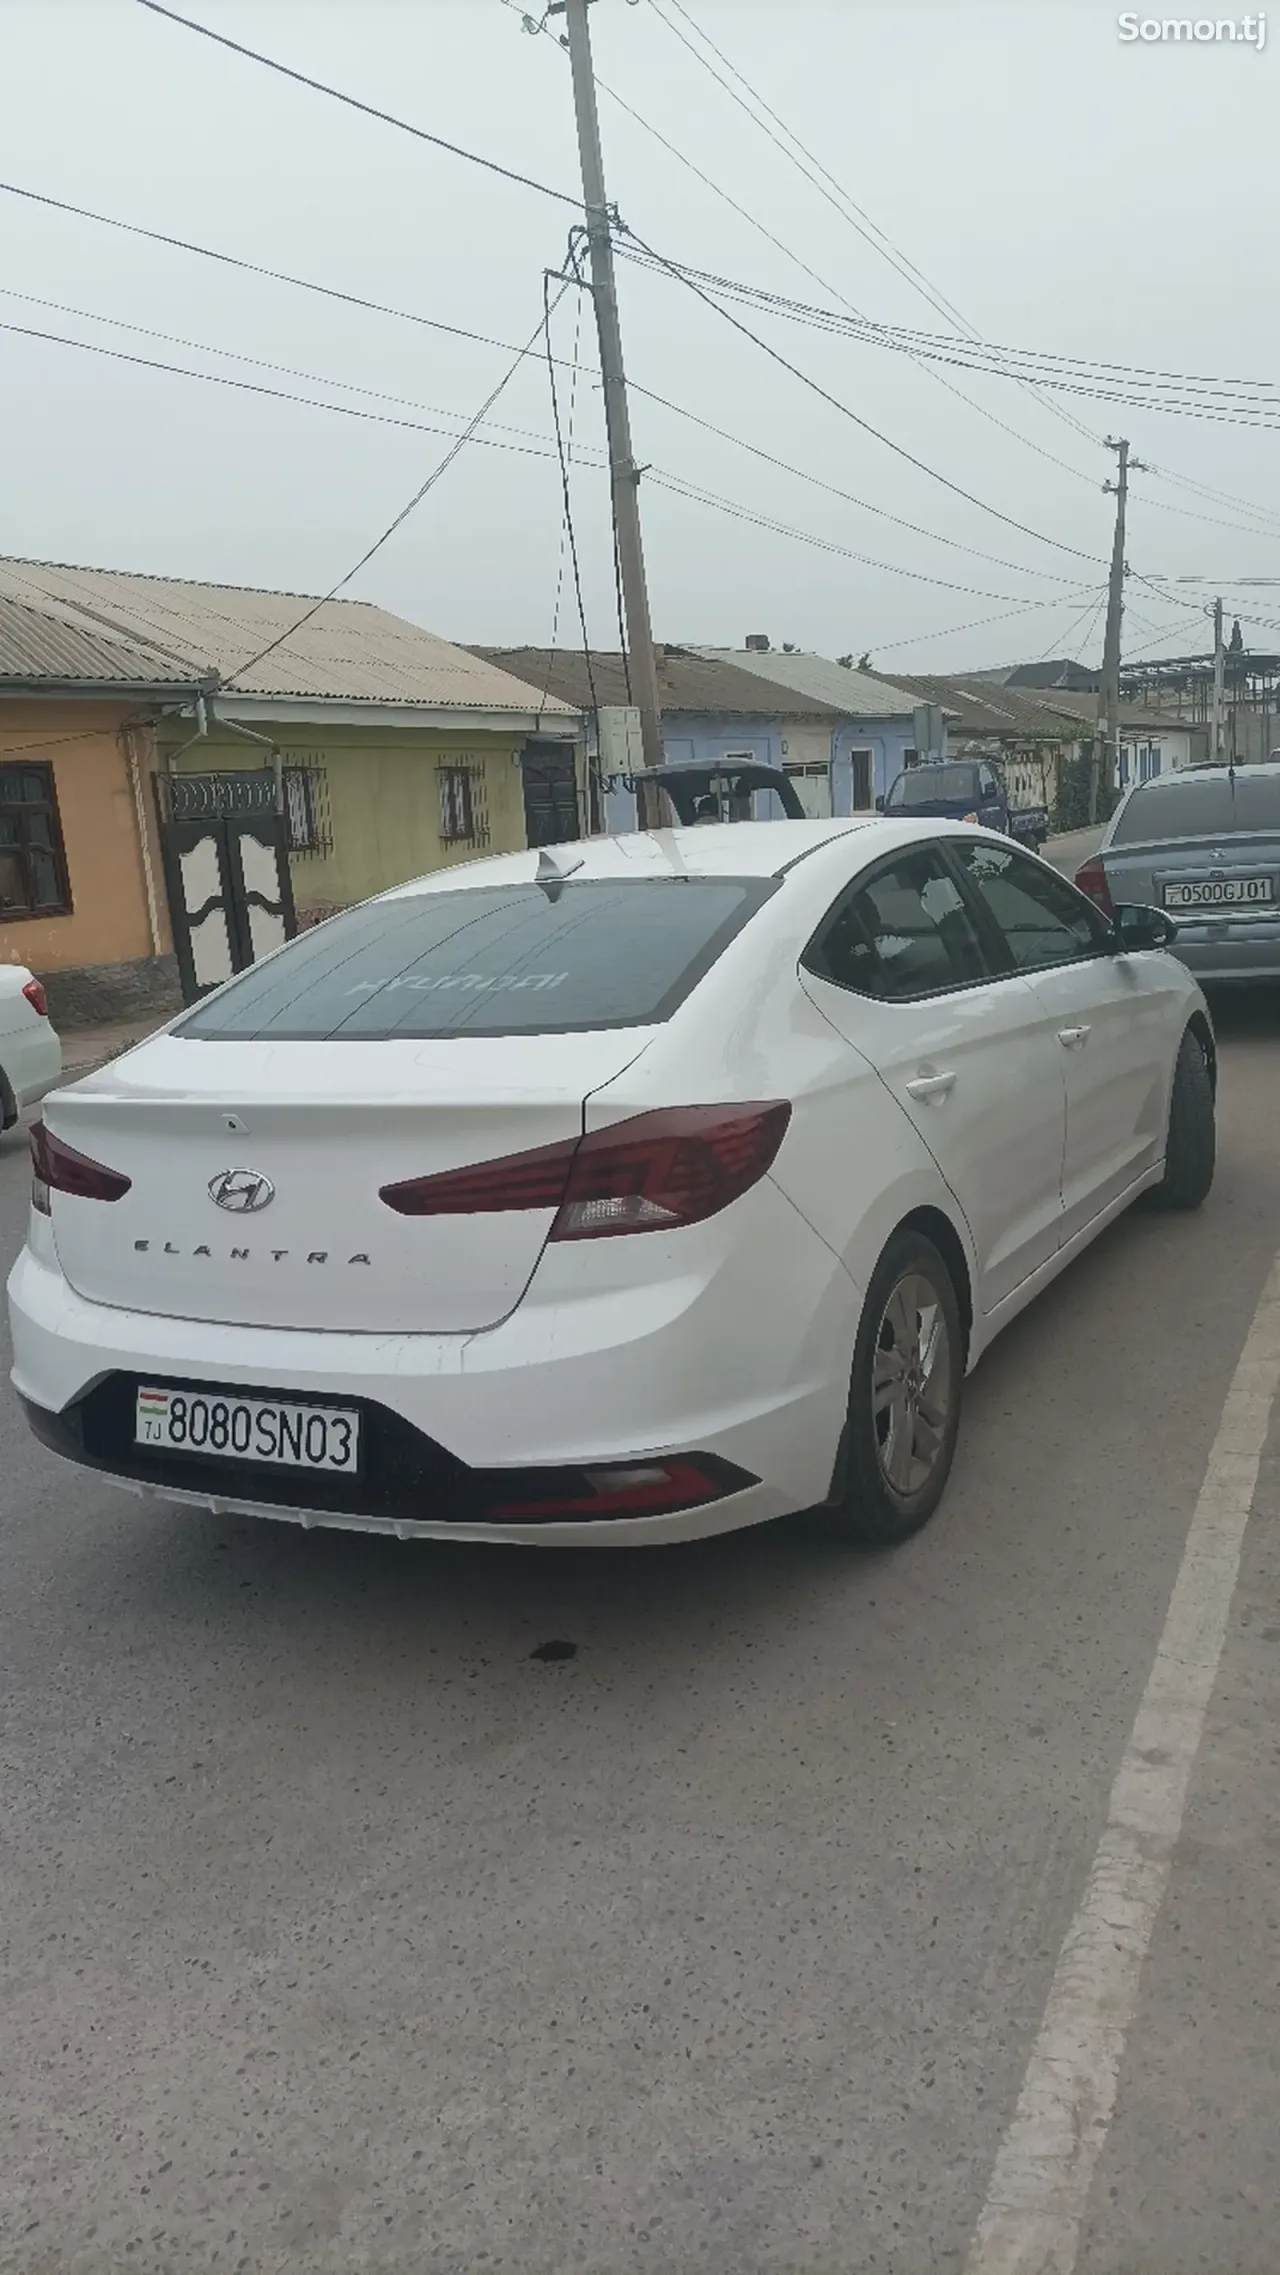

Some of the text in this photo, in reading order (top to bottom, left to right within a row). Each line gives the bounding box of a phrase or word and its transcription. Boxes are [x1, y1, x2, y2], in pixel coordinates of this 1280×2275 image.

[1181, 880, 1267, 902] 0500GJ01
[134, 1240, 371, 1265] ELANTRA
[168, 1397, 352, 1466] 8080SN03
